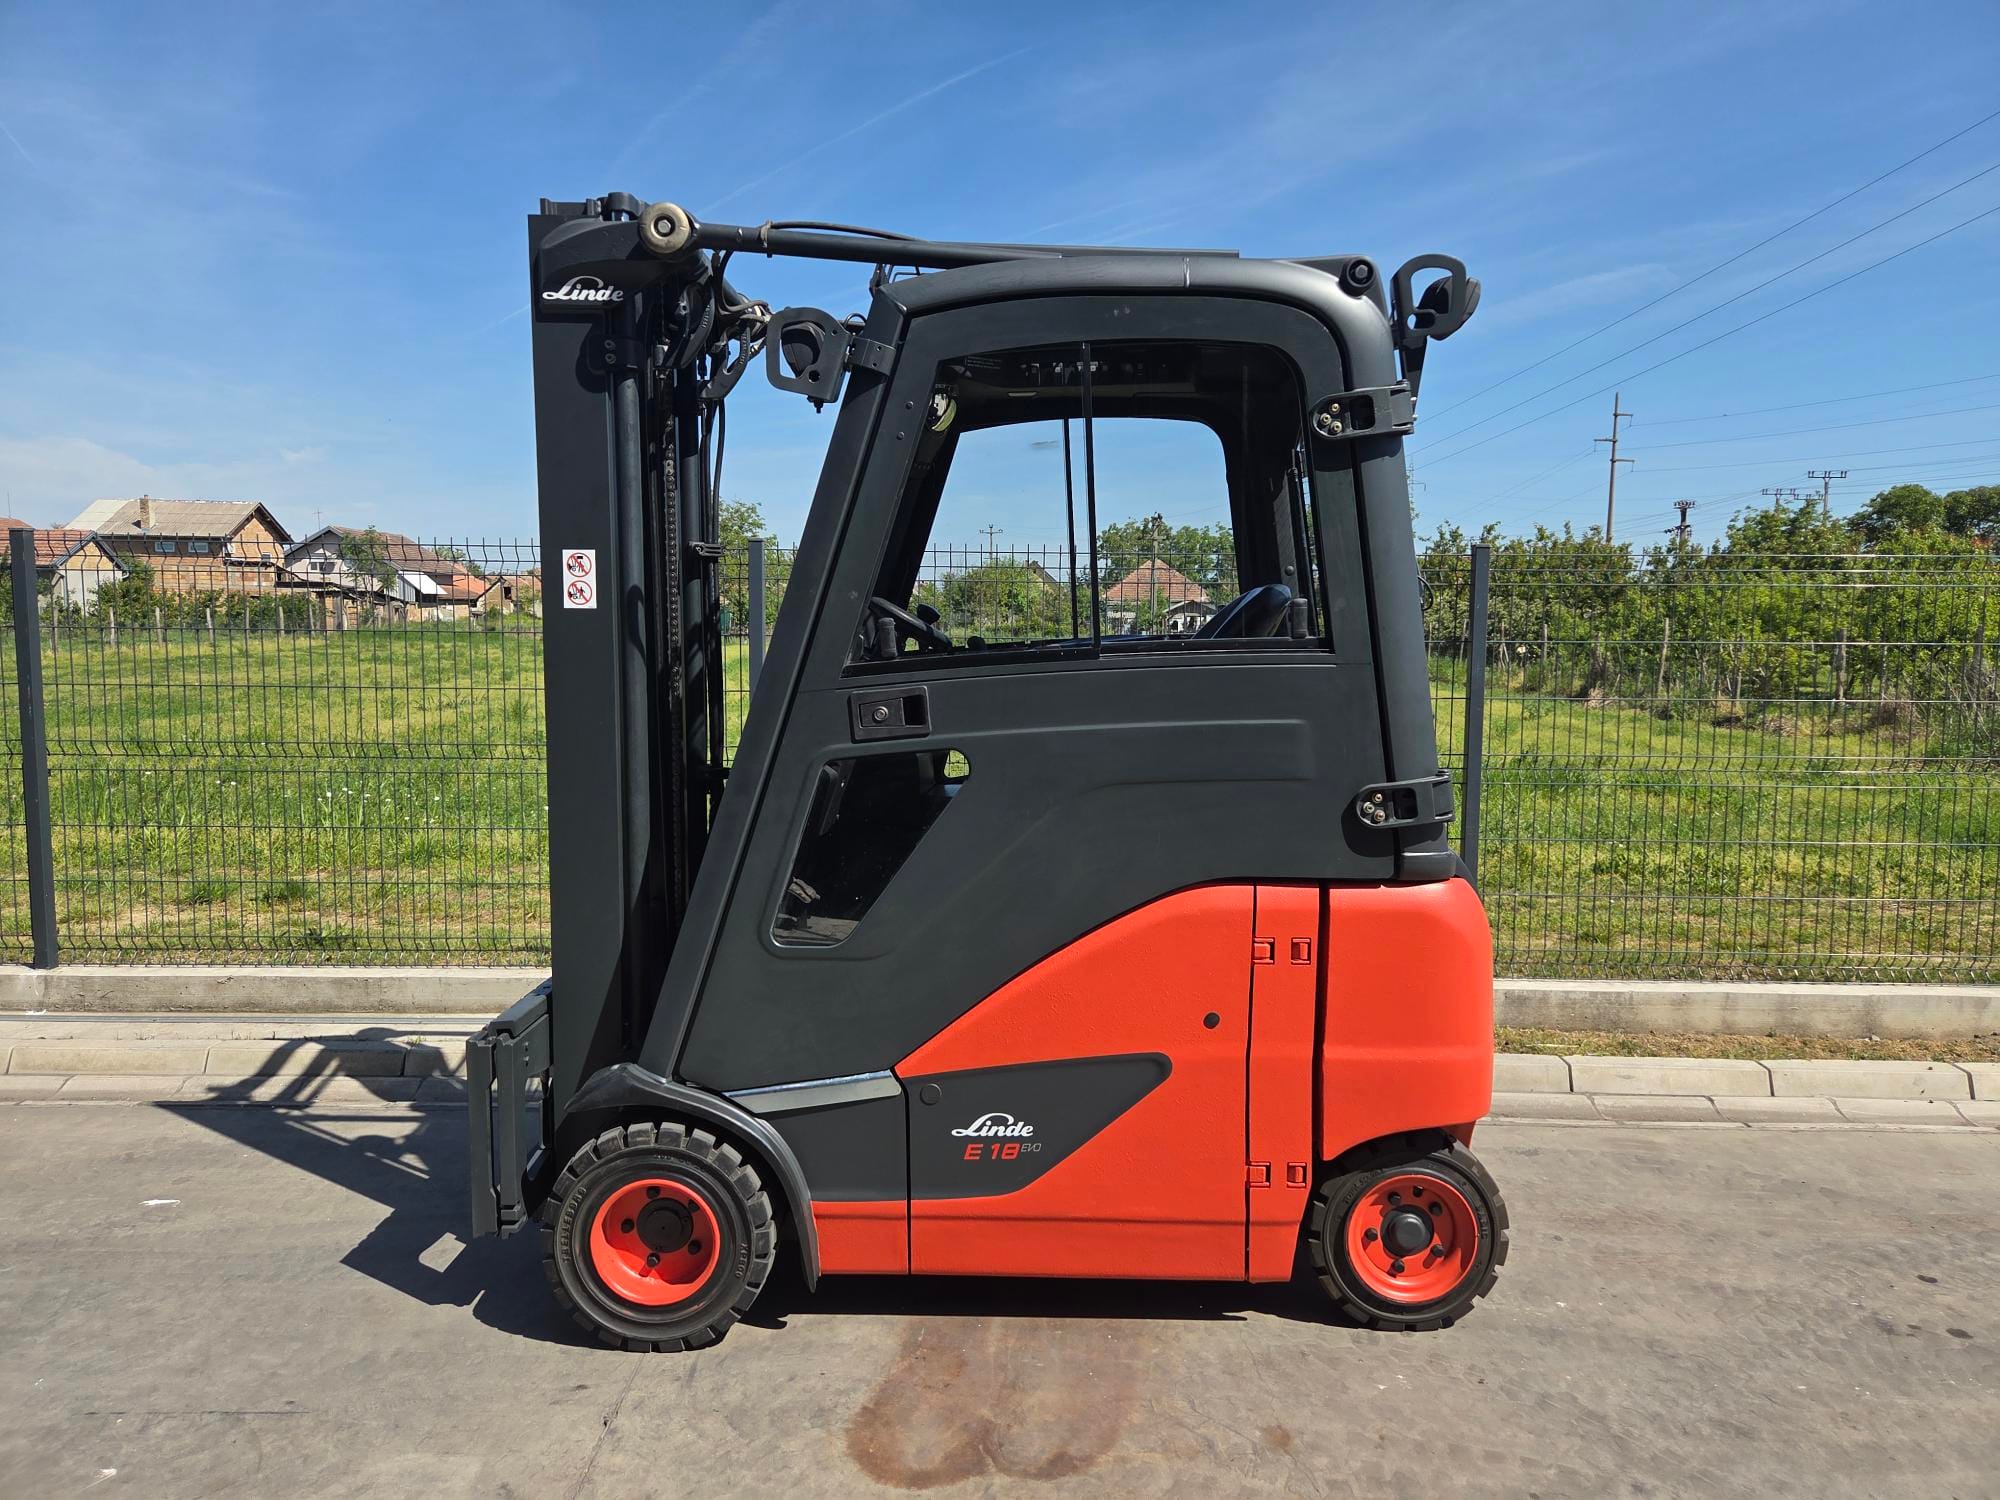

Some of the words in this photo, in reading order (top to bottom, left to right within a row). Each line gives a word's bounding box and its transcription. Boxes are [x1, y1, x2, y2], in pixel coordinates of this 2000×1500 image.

[542, 275, 624, 302] Linde
[951, 1112, 1034, 1137] Linde
[963, 1143, 984, 1160] E
